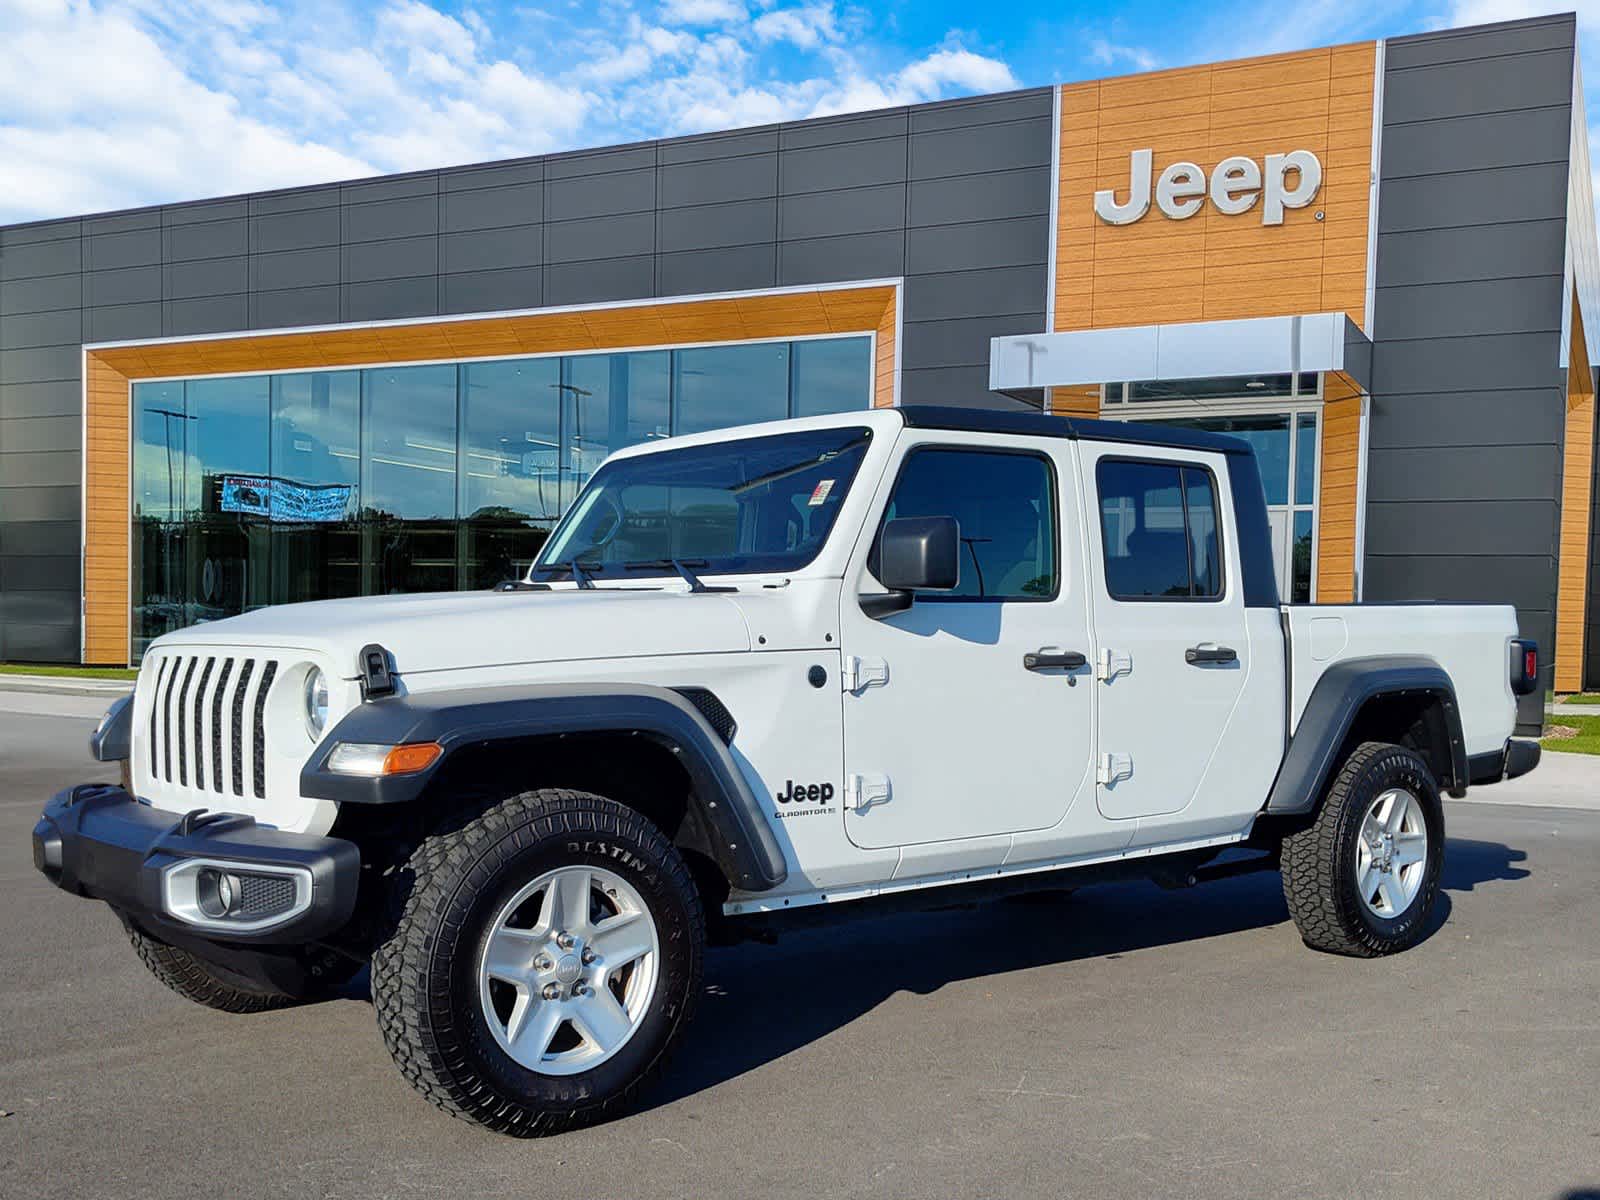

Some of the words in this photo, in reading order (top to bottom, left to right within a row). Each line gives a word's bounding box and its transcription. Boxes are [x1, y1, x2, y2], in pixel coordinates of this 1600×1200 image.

[1094, 148, 1322, 226] Jeep
[776, 780, 834, 805] Jeep
[774, 808, 827, 819] GLADIATOR
